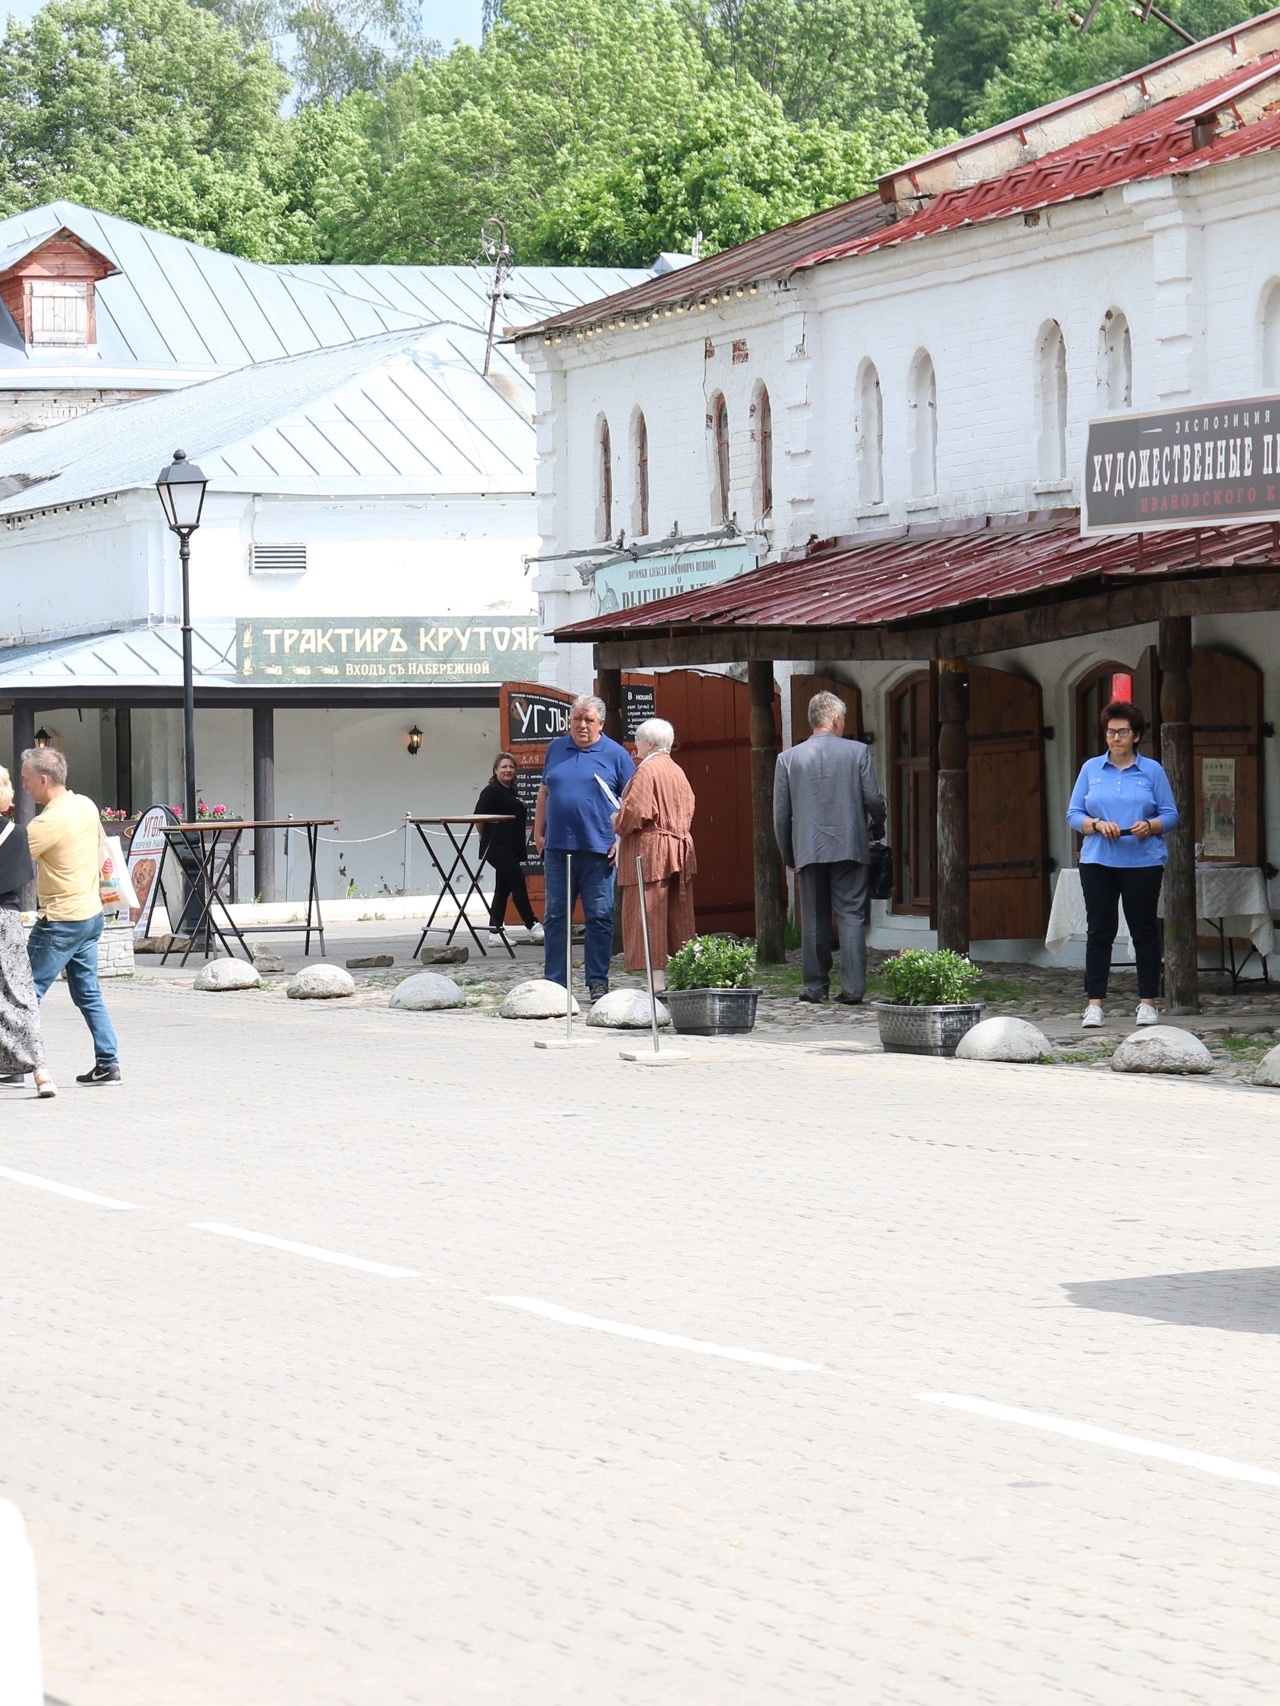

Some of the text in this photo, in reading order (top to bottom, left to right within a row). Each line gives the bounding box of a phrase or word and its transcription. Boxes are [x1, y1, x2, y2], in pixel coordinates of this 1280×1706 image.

[1175, 410, 1271, 434] ЭКСПОЗИЦИЯ
[1092, 436, 1253, 497] ХУДОЖЕСТВЕННЫЕ
[1140, 487, 1256, 513] ИВАНОВСКОГО
[262, 627, 408, 653] ТРАКТИРЪ
[345, 663, 386, 676] ВХОДЪ
[408, 661, 490, 675] НАБЕРЕЖНОЙ
[627, 691, 633, 700] В
